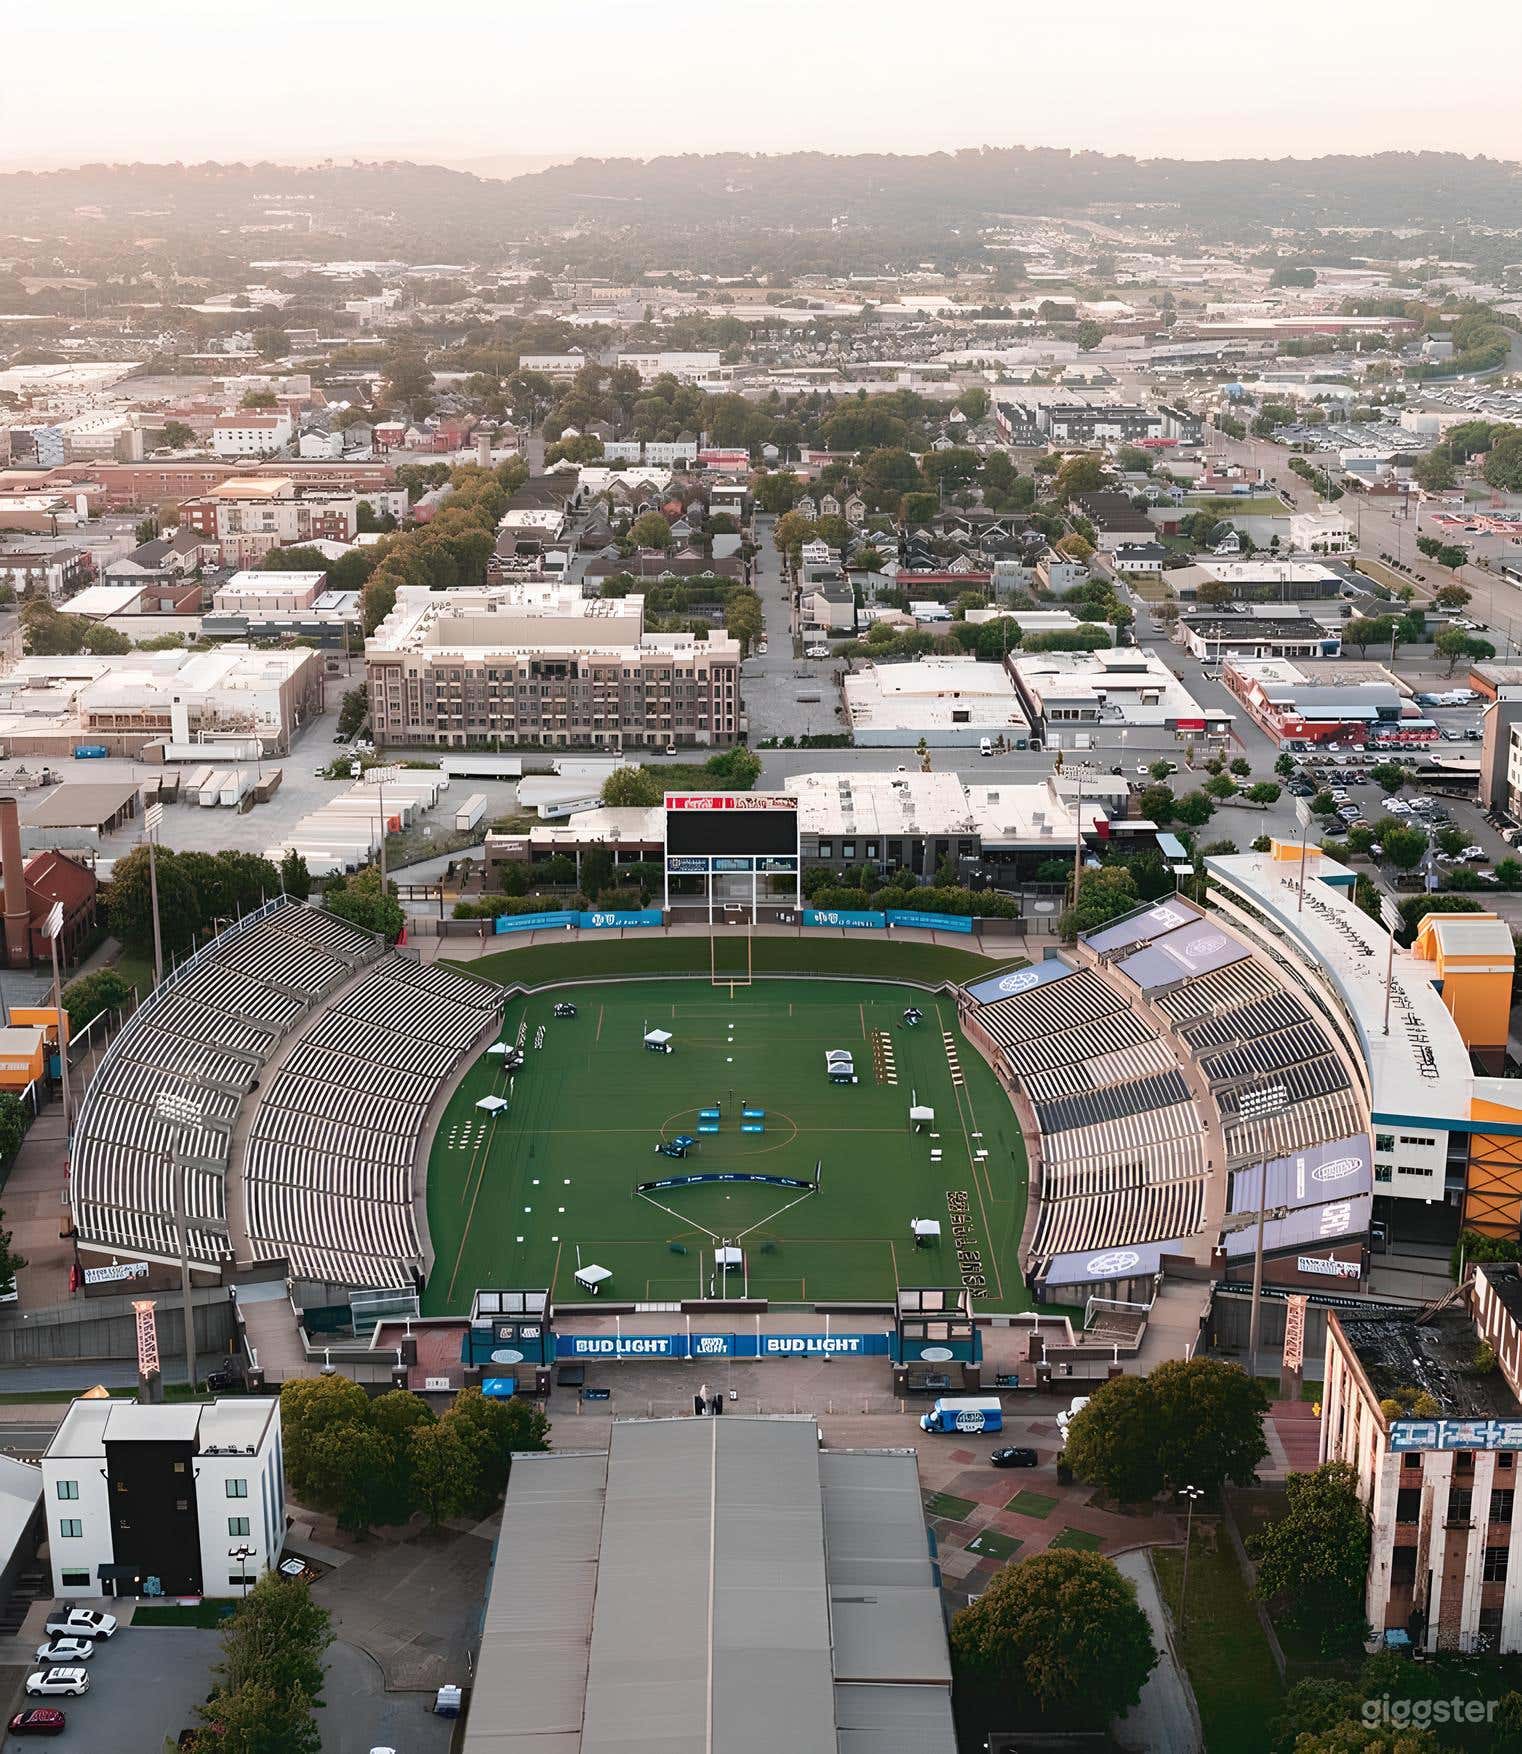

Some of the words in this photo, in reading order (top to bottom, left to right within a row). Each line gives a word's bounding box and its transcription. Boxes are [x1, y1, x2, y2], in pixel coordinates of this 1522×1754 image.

[576, 1339, 613, 1352] BUD
[616, 1339, 669, 1353] LIGHT
[767, 1339, 806, 1351] BUD
[807, 1339, 859, 1351] LIGHT
